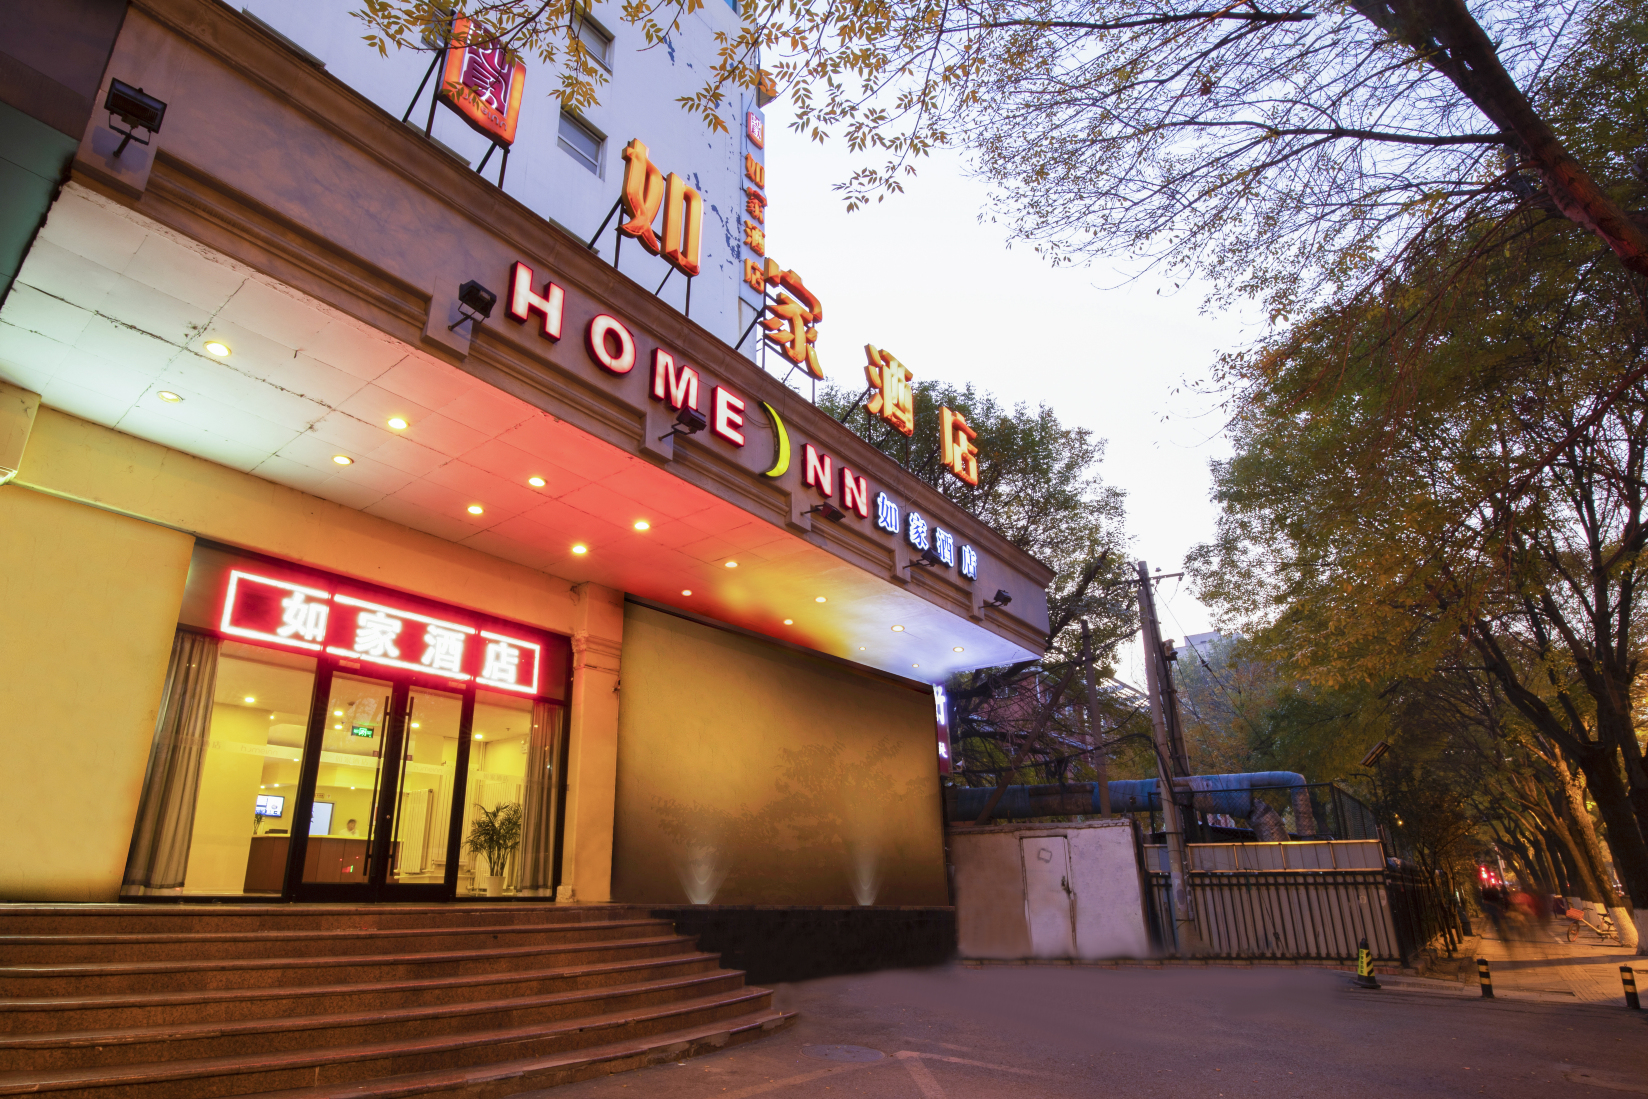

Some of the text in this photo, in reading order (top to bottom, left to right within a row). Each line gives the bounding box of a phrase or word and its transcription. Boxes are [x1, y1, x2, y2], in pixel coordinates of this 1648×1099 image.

[743, 152, 768, 295] 如家酒店
[505, 260, 746, 447] HOME
[614, 137, 979, 487] 如家酒店
[874, 491, 978, 581] 如家酒店
[276, 591, 520, 684] 如家酒店
